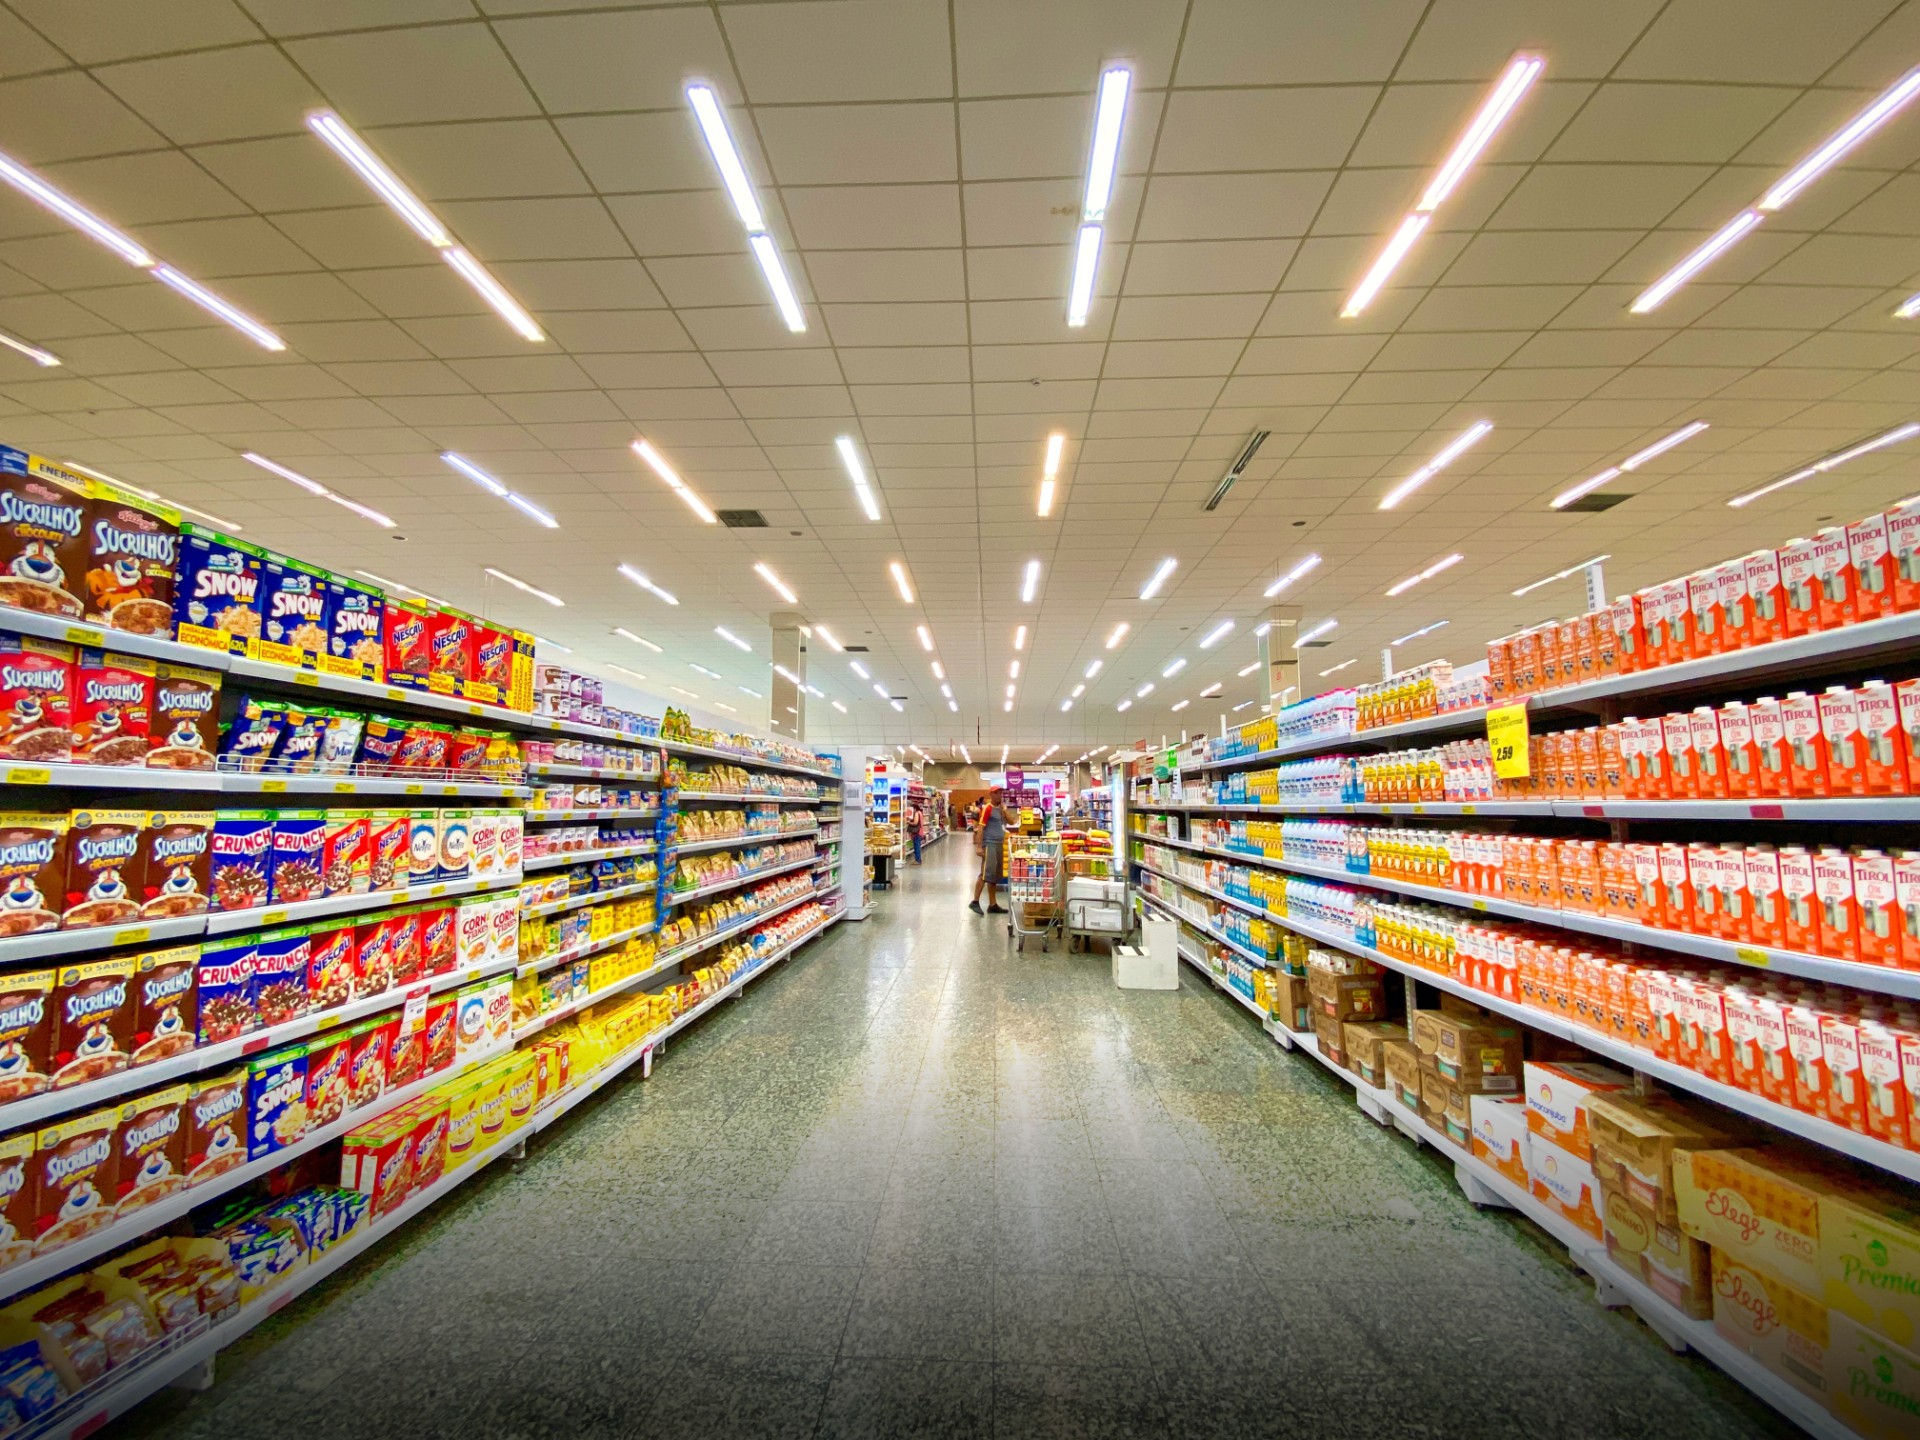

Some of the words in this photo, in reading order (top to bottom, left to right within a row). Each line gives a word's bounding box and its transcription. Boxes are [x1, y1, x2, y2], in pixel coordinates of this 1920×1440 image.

[40, 463, 86, 487] ENERGIA
[0, 491, 83, 536] SUCRILHOS
[1889, 515, 1920, 533] TIRO
[95, 521, 176, 566] SUCRILHOS
[1849, 528, 1885, 546] TIROL
[1813, 541, 1846, 558] TIROL
[1780, 551, 1813, 568] TIROL
[1717, 573, 1745, 587] TIROL
[1747, 563, 1776, 578] TIROL
[194, 569, 258, 598] SNOW
[1690, 582, 1715, 595] TIROL
[271, 592, 323, 617] SNOW
[1643, 598, 1663, 611] TIROL
[1663, 590, 1686, 604] TIROL
[335, 611, 380, 634] SNOW
[180, 632, 228, 651] ECONÔMICA
[392, 620, 424, 646] NESCAU
[432, 626, 467, 652] NESCAU
[261, 650, 301, 665] ECONÔMICA
[478, 638, 509, 664] NESCAU
[3, 666, 65, 692] SUCRILHOS
[86, 680, 145, 704] SUCRILHOS
[159, 689, 213, 712] SUCRILHOS
[1821, 704, 1856, 717] TIROL
[1858, 699, 1893, 712] TIROL
[1721, 718, 1749, 729] TIROL
[1752, 714, 1780, 725] TIROL
[1783, 709, 1816, 722] TIROL
[1620, 731, 1639, 740] TIROL
[1640, 728, 1660, 738] TIROL
[1665, 725, 1688, 736] TIROL
[1691, 722, 1715, 733] TIROL
[233, 730, 280, 750] SNOW
[21, 815, 68, 823] SABOR
[213, 829, 272, 853] CRUNCH
[274, 827, 326, 850] CRUNCH
[334, 825, 366, 855] NESCAU
[378, 824, 406, 851] NESCAU
[472, 827, 495, 845] CORN
[501, 826, 520, 843] CORN
[78, 833, 139, 865] SUCRILHOS
[153, 832, 207, 861] SUCRILHOS
[1636, 855, 1656, 865] TIROL
[1661, 856, 1684, 868] TIROL
[1690, 858, 1714, 870] TIROL
[1714, 860, 1743, 872] TIROL
[1746, 862, 1776, 874] TIROL
[1782, 864, 1811, 877] TIROL
[1815, 866, 1850, 880] TIROL
[1855, 869, 1892, 883] TIROL
[462, 913, 487, 935] CORN
[493, 908, 515, 928] CORN
[424, 912, 453, 946] NESCAU
[312, 935, 351, 976] NESCAU
[359, 928, 391, 966] NESCAU
[96, 960, 135, 971] SABOR
[257, 944, 311, 973] CRUNCH
[200, 953, 258, 985] CRUNCH
[10, 973, 53, 985] SABOR
[144, 967, 193, 1006] SUCRILHOS
[67, 981, 127, 1023] SUCRILHOS
[1649, 985, 1672, 1000] TIROL
[1672, 991, 1695, 1007] TIROL
[488, 993, 509, 1013] CORN
[1695, 998, 1721, 1015] TIROL
[427, 1006, 455, 1042] NESCAU
[1725, 1007, 1754, 1023] TIROL
[1754, 1014, 1784, 1033] TIROL
[1787, 1023, 1821, 1041] TIROL
[1823, 1032, 1857, 1052] TIROL
[351, 1034, 384, 1077] NESCAU
[1861, 1042, 1897, 1062] TIROL
[310, 1049, 347, 1096] NESCAU
[255, 1076, 304, 1121] SNOW
[195, 1087, 243, 1130] SUCRILHOS
[125, 1108, 180, 1156] SUCRILHOS
[47, 1134, 111, 1187] SUCRILHOS
[1774, 1229, 1814, 1256] ZERO
